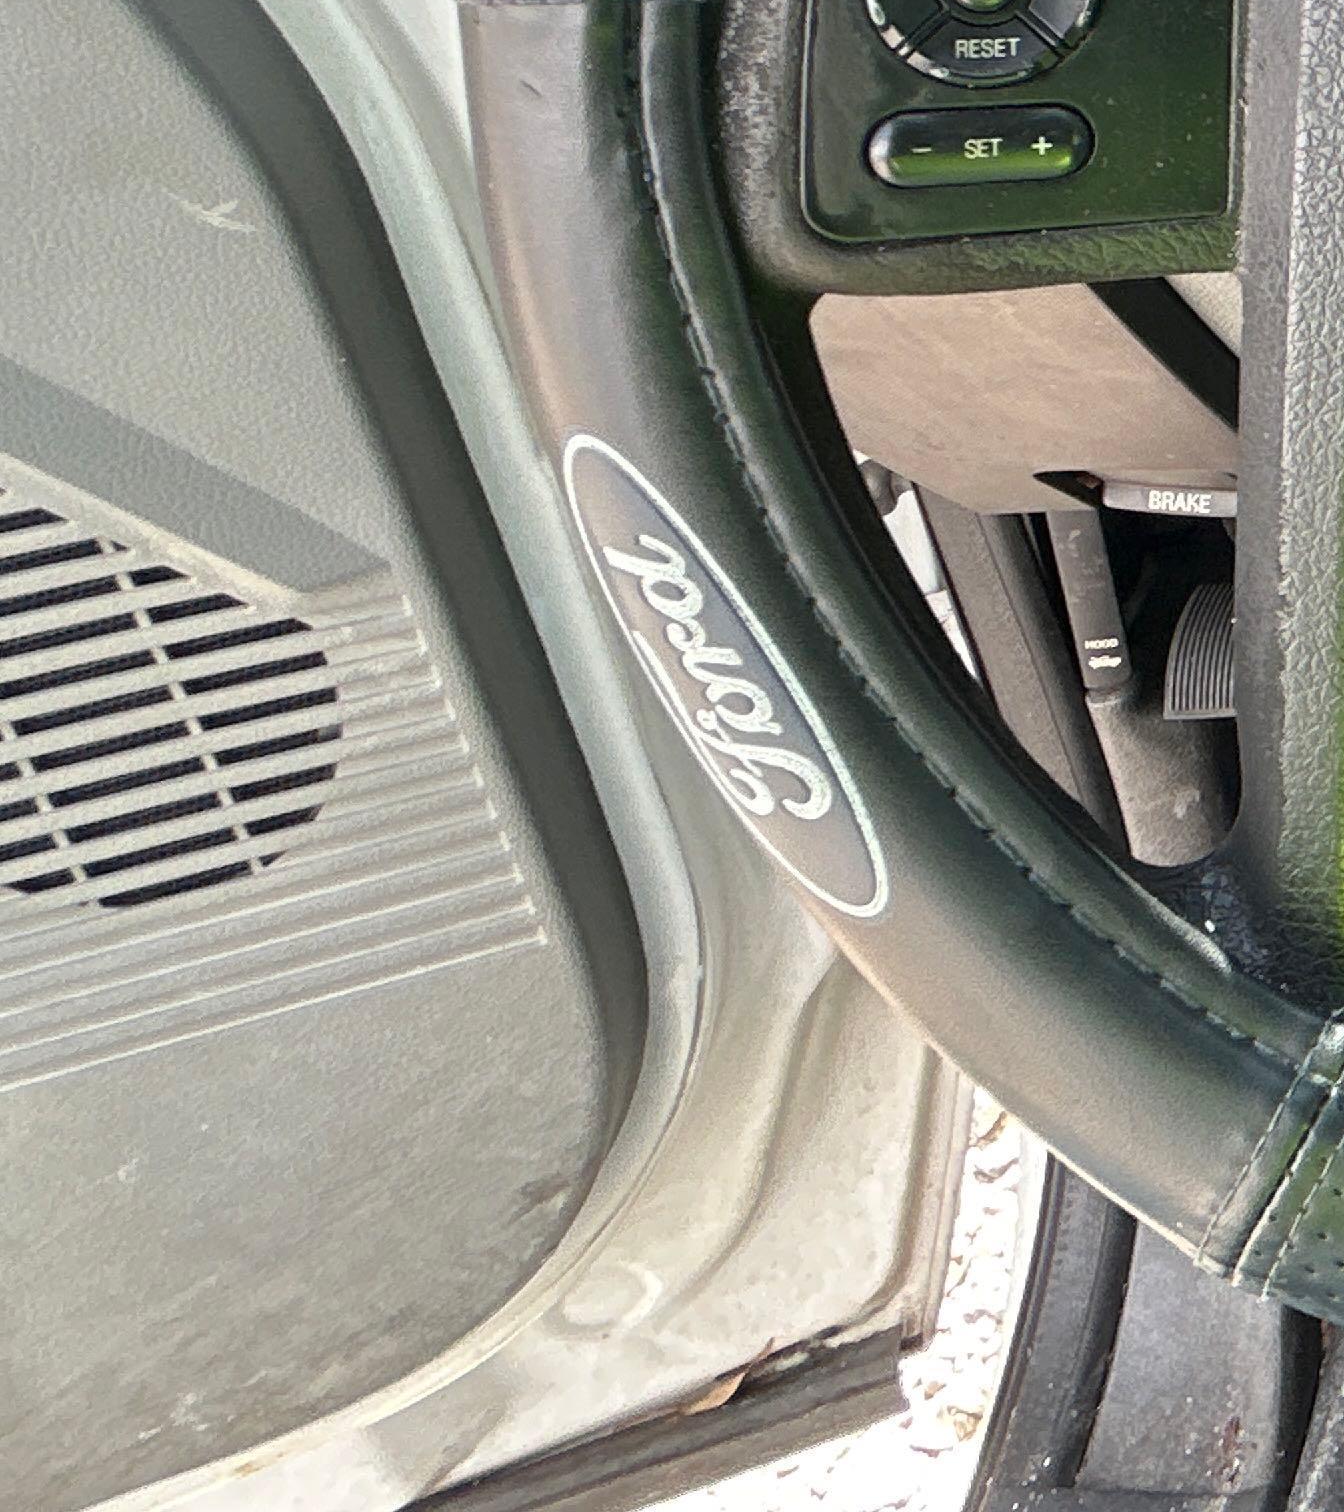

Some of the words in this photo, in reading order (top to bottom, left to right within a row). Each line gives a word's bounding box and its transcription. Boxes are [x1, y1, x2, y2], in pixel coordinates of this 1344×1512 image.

[954, 38, 1021, 59] RESET
[964, 138, 1004, 160] SET
[1147, 490, 1212, 514] BRAKE
[603, 534, 833, 821] Ford
